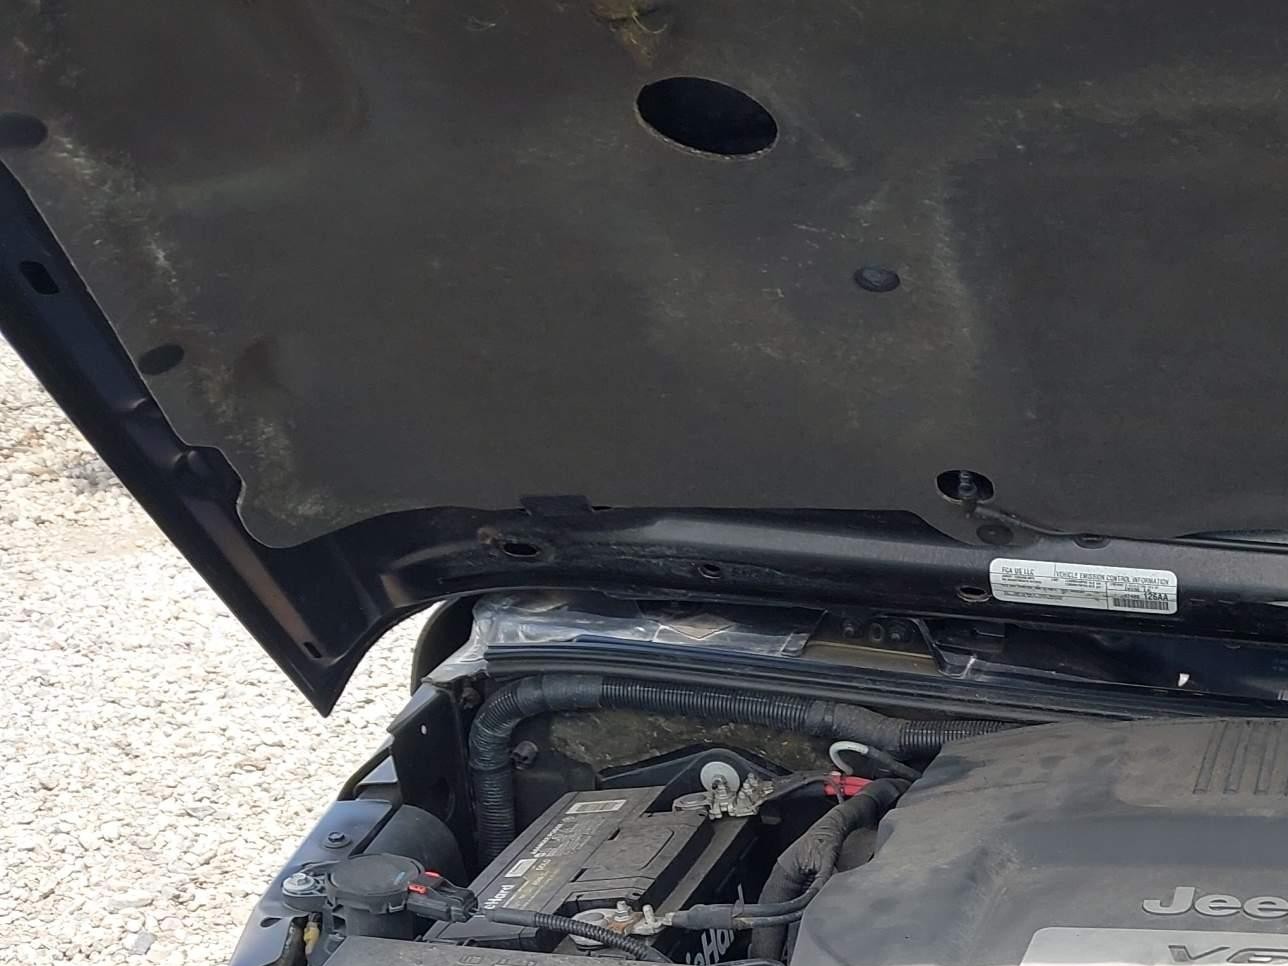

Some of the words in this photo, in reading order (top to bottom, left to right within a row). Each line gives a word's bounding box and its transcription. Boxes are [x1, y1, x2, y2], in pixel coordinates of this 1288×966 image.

[1079, 572, 1105, 580] EMISSION
[1106, 573, 1130, 582] CONTROL
[1132, 576, 1169, 585] INFORMATION
